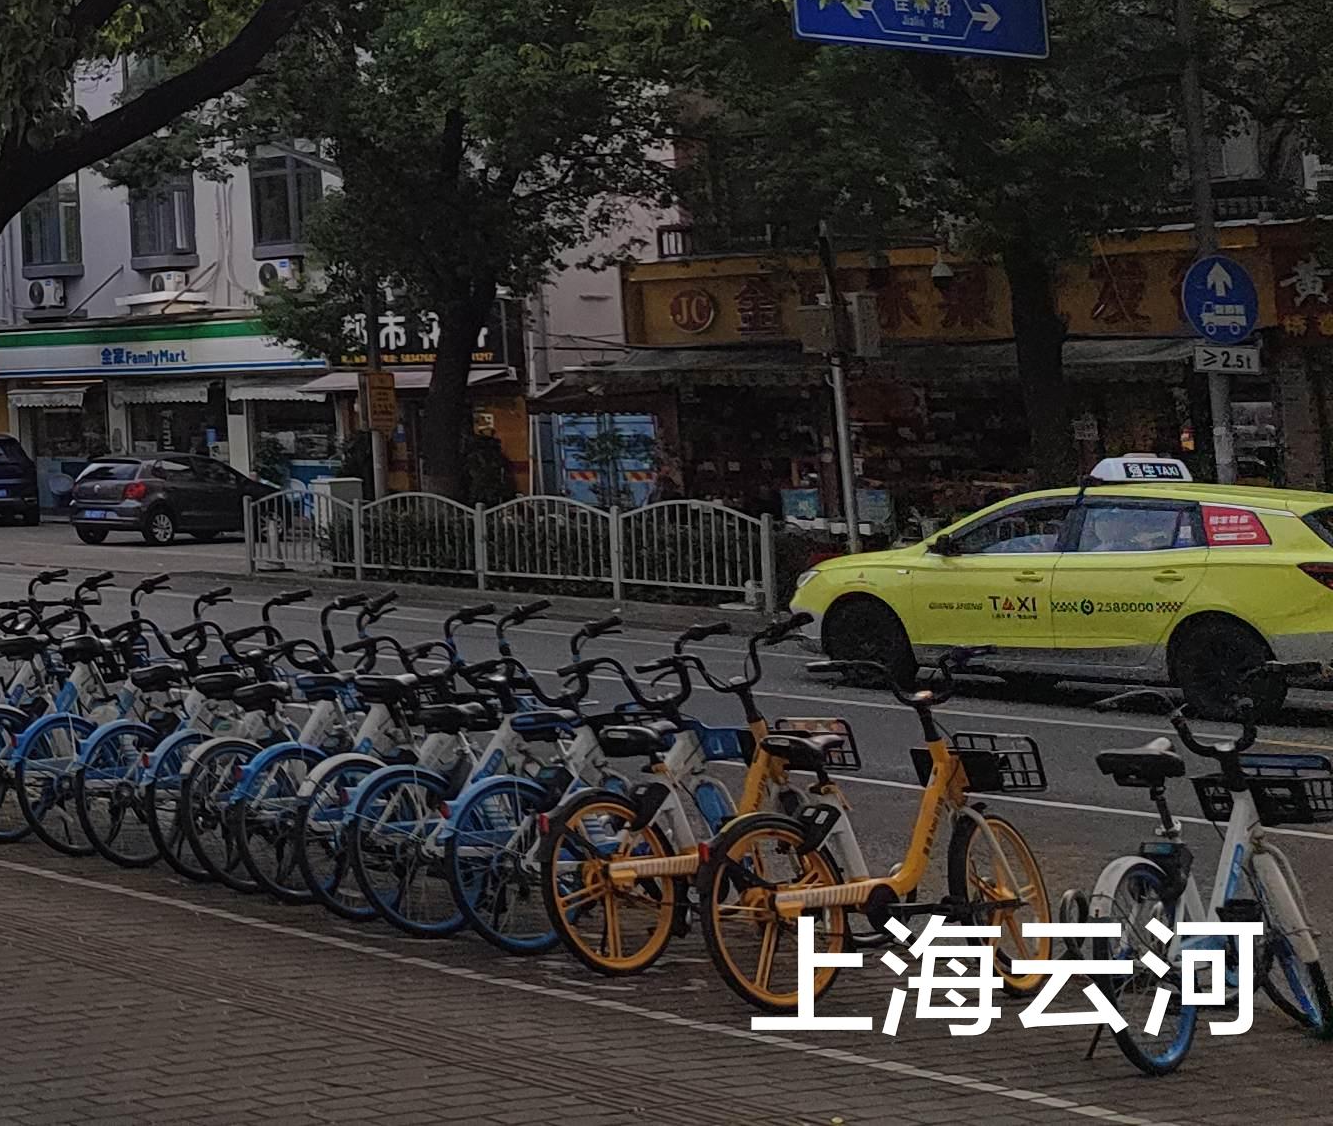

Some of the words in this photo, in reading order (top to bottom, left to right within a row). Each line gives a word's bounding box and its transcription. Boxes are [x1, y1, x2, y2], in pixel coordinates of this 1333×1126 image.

[933, 18, 945, 29] Rd
[674, 296, 709, 325] JC
[125, 349, 188, 366] FamilyMart
[1156, 465, 1180, 477] TAXI
[988, 595, 1037, 612] TAXI
[1097, 602, 1154, 613] 2580000
